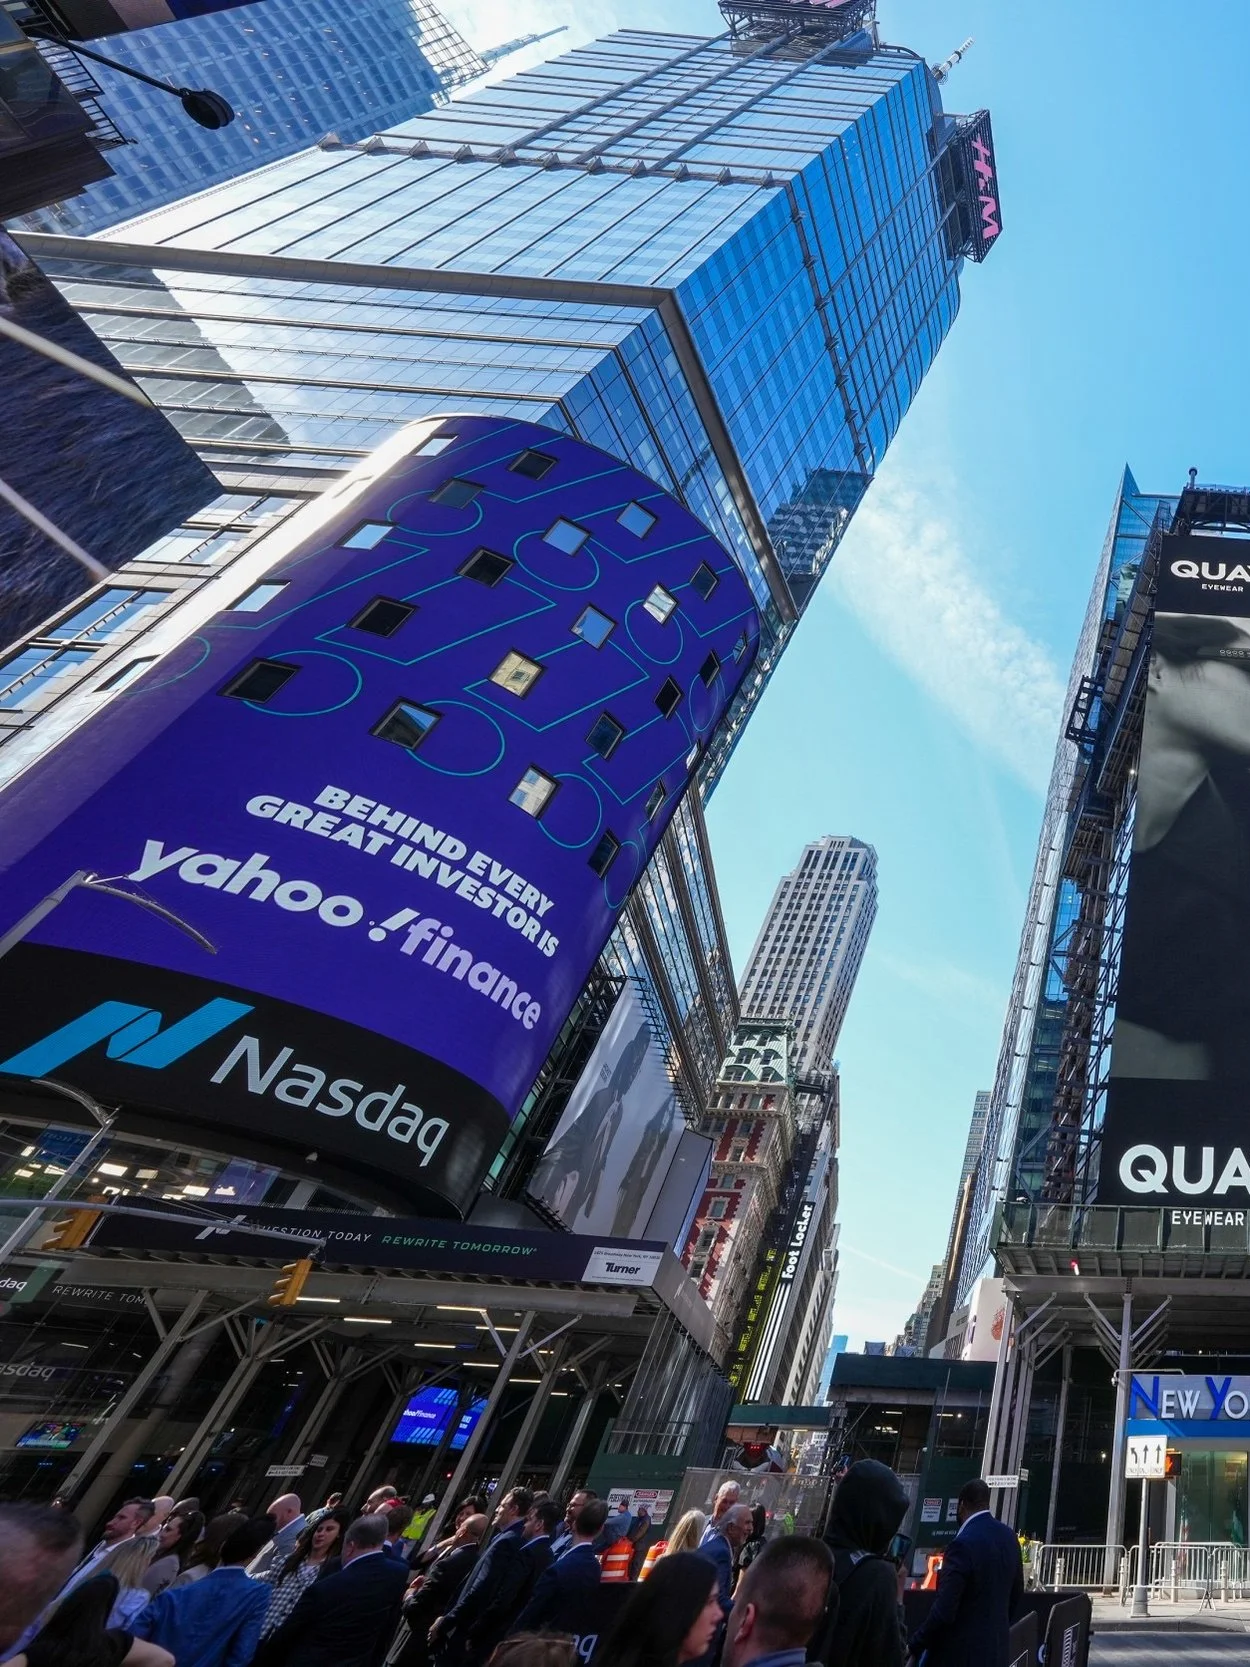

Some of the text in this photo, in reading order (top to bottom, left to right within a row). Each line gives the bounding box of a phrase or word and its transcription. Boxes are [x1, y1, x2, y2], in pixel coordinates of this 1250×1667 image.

[1201, 583, 1244, 592] EYEWEAR
[313, 785, 555, 917] BEHIND EVERY
[245, 795, 560, 957] GREAT INVESTOR IS
[210, 1034, 450, 1167] Nasdaq
[1171, 1210, 1245, 1227] EYEWEAR
[262, 1224, 323, 1239] UESTION
[328, 1230, 372, 1243] TODAY
[382, 1235, 448, 1249] REWRITE
[781, 1204, 814, 1280] Foot Locker
[605, 1261, 641, 1275] Turner
[52, 1285, 114, 1301] REWRITE
[1130, 1375, 1201, 1421] NEW
